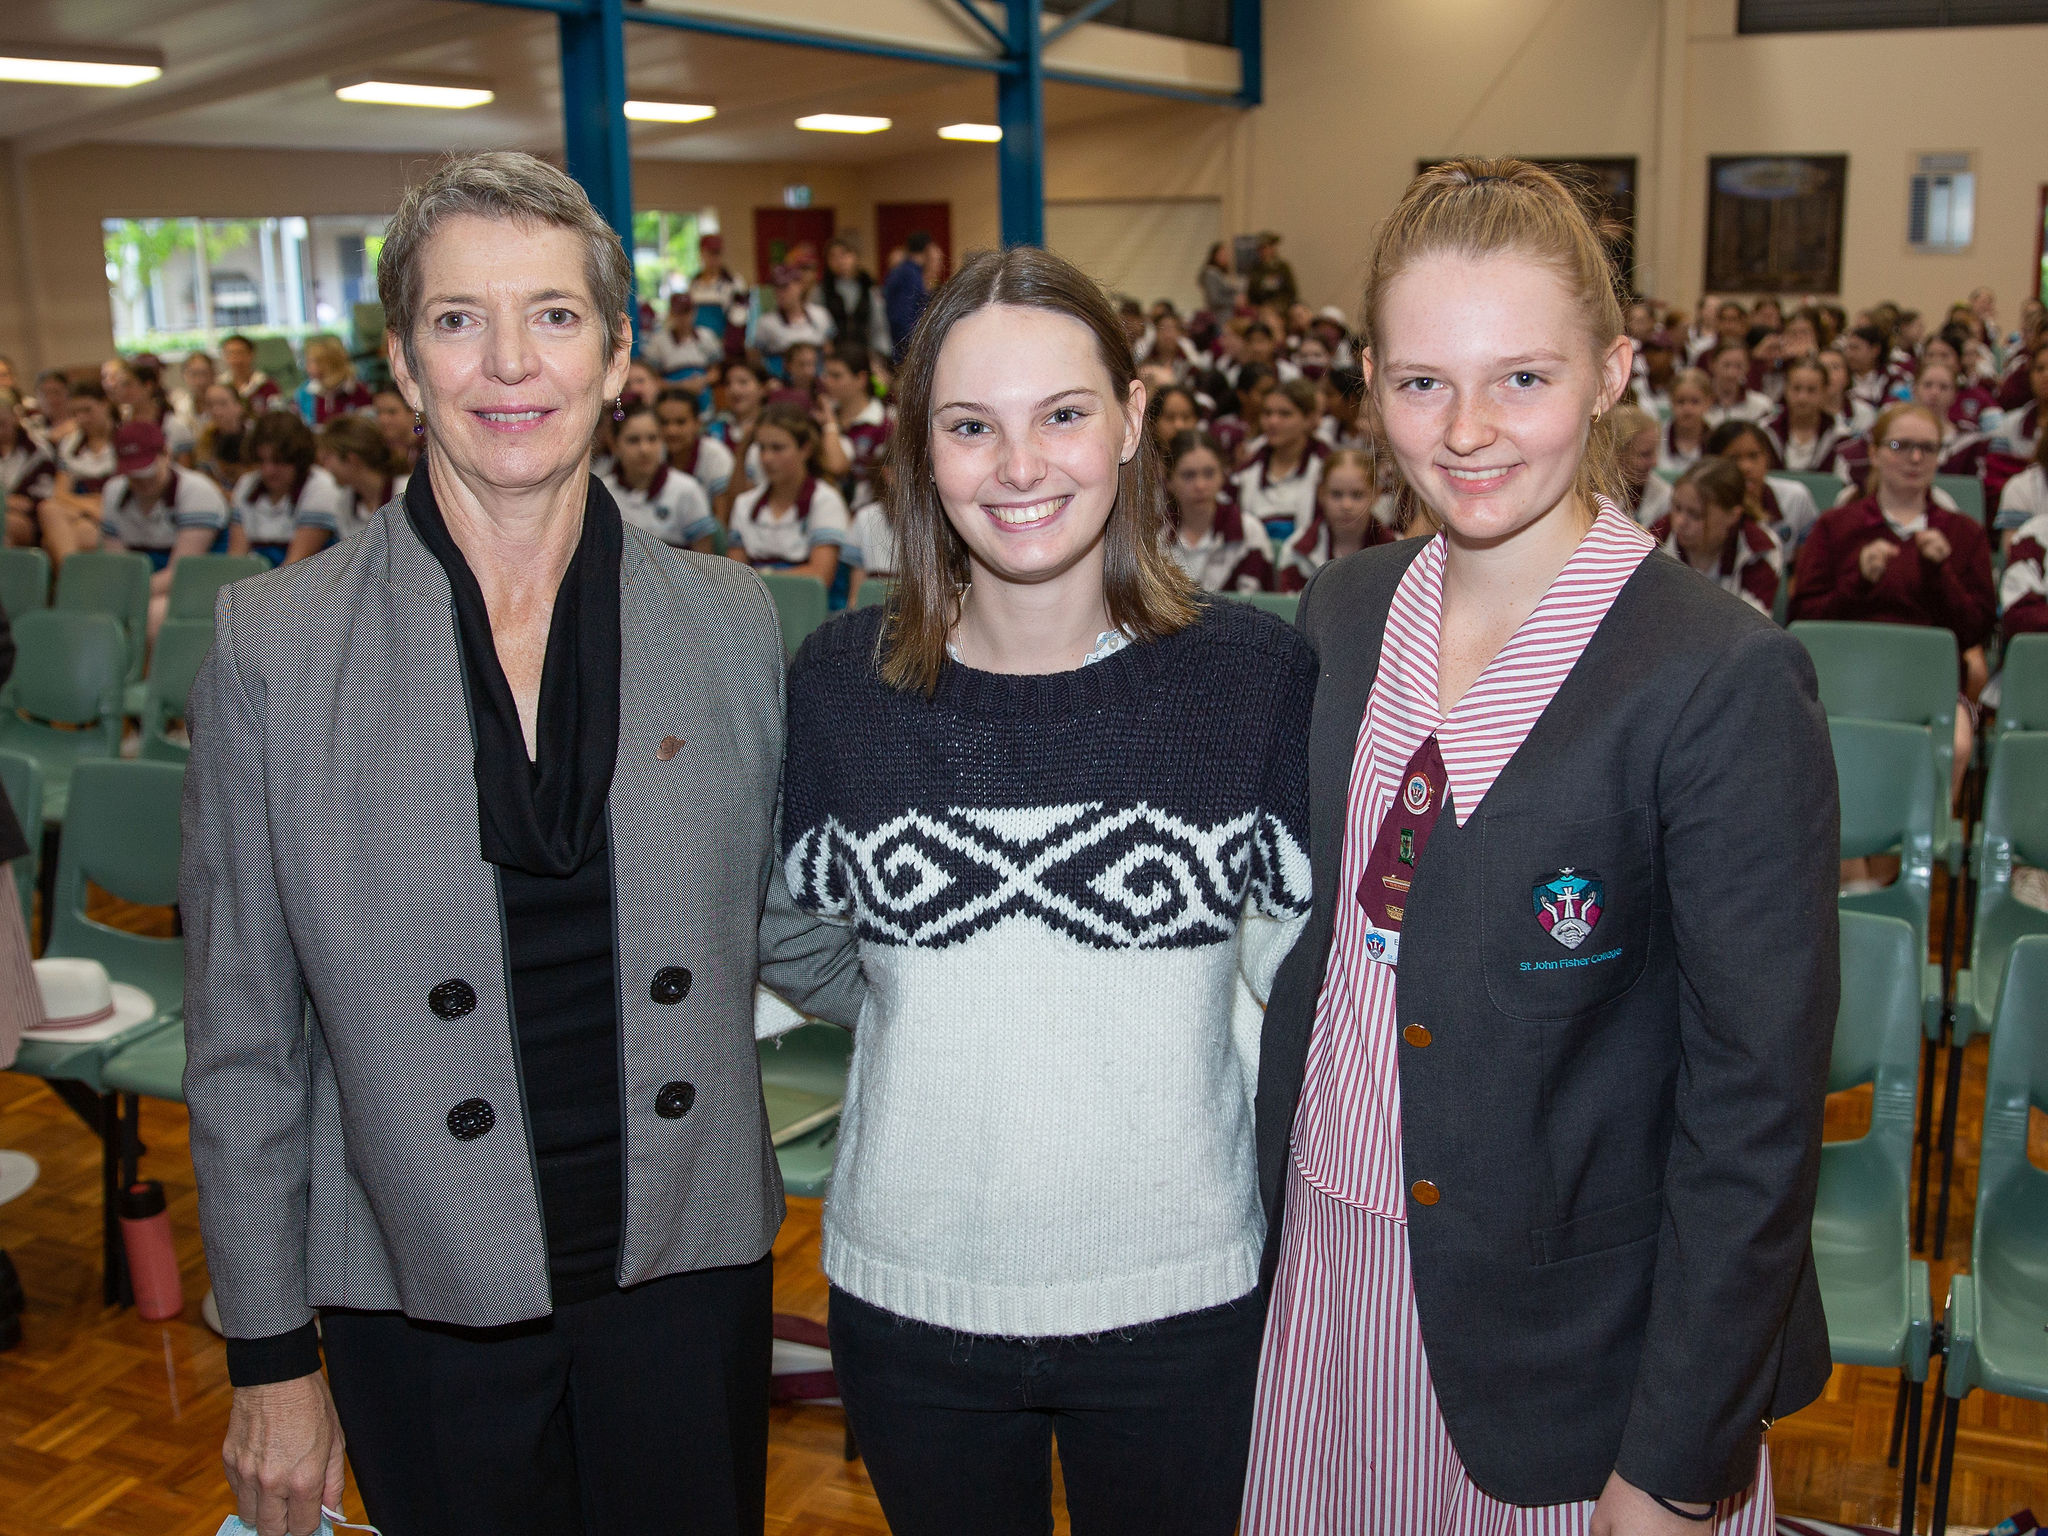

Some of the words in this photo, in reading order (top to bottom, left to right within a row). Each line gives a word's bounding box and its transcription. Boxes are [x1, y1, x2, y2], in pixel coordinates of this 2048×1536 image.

[1520, 962, 1531, 971] St
[1533, 961, 1557, 970] John
[1560, 958, 1589, 968] Fisher
[1591, 947, 1622, 963] College
